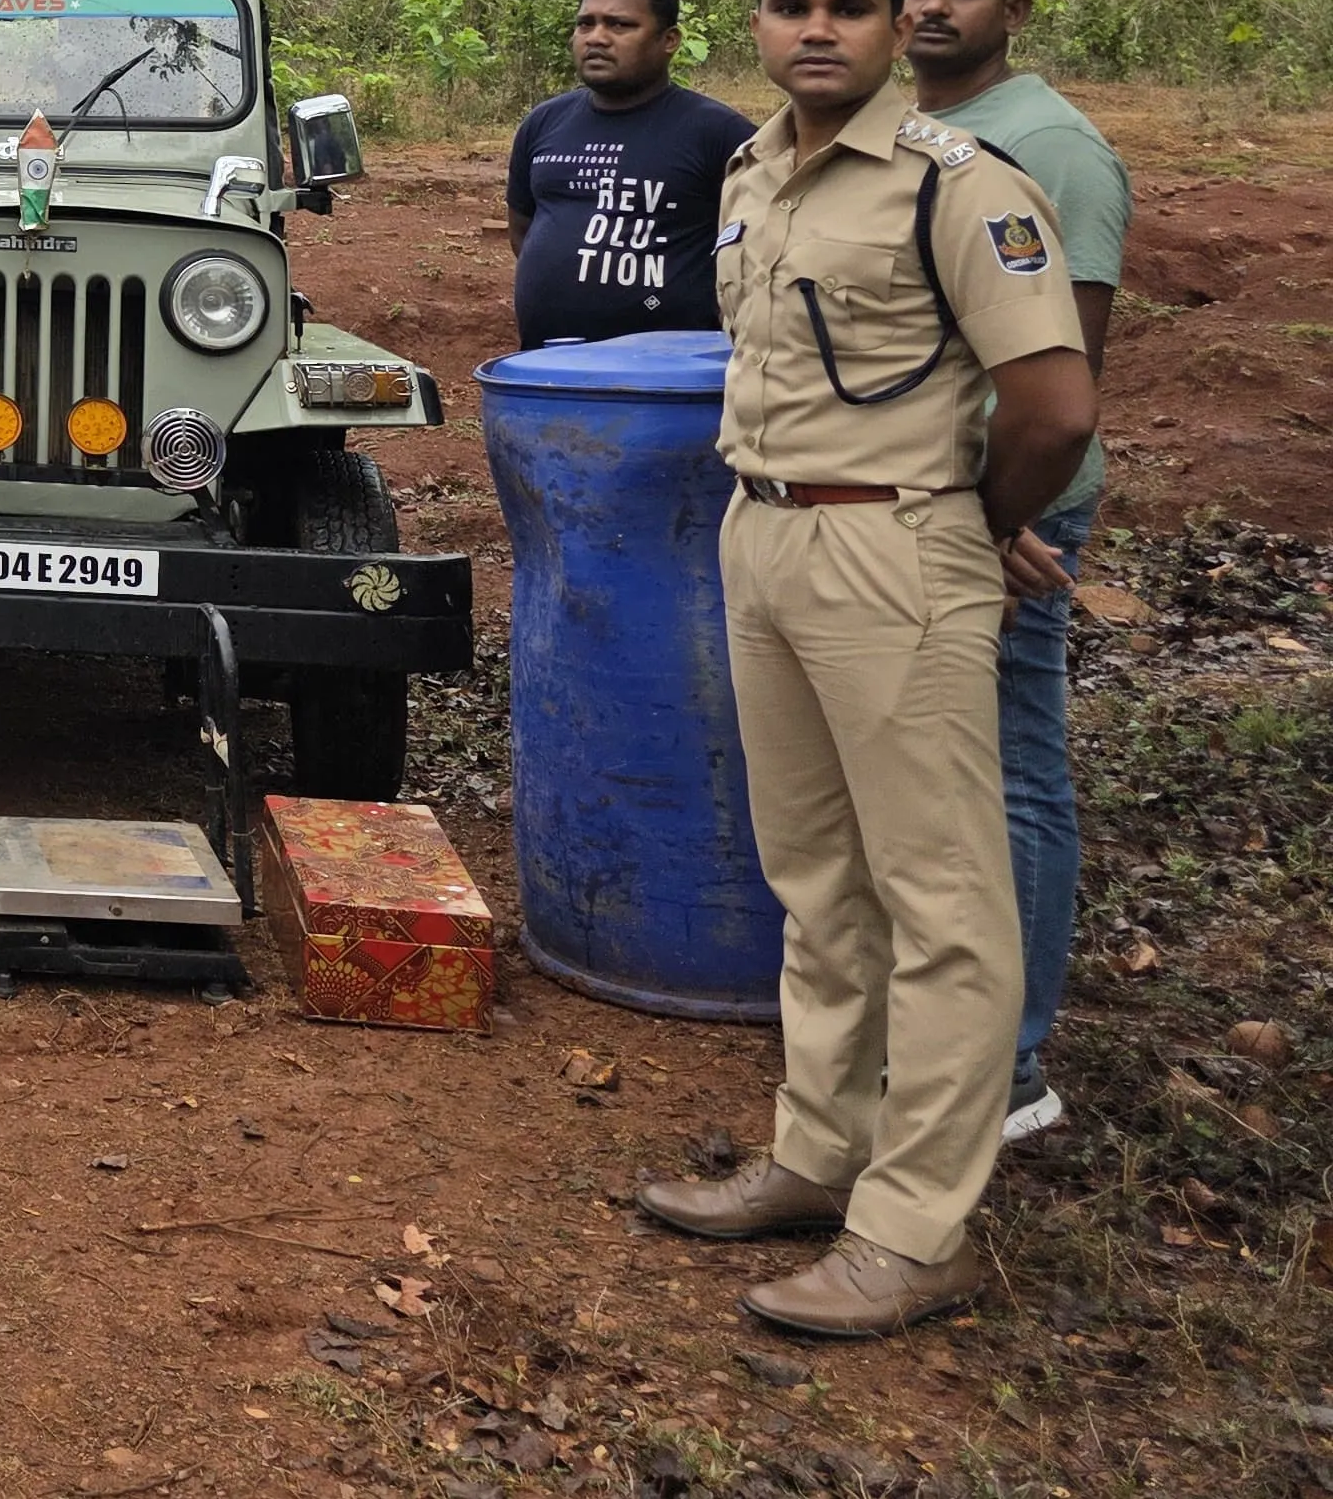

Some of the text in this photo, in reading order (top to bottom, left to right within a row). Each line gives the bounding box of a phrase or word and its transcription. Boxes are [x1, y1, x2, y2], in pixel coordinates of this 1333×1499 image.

[584, 214, 668, 249] OLU-
[578, 249, 664, 287] TION
[38, 553, 52, 583] E
[59, 554, 143, 588] 2949
